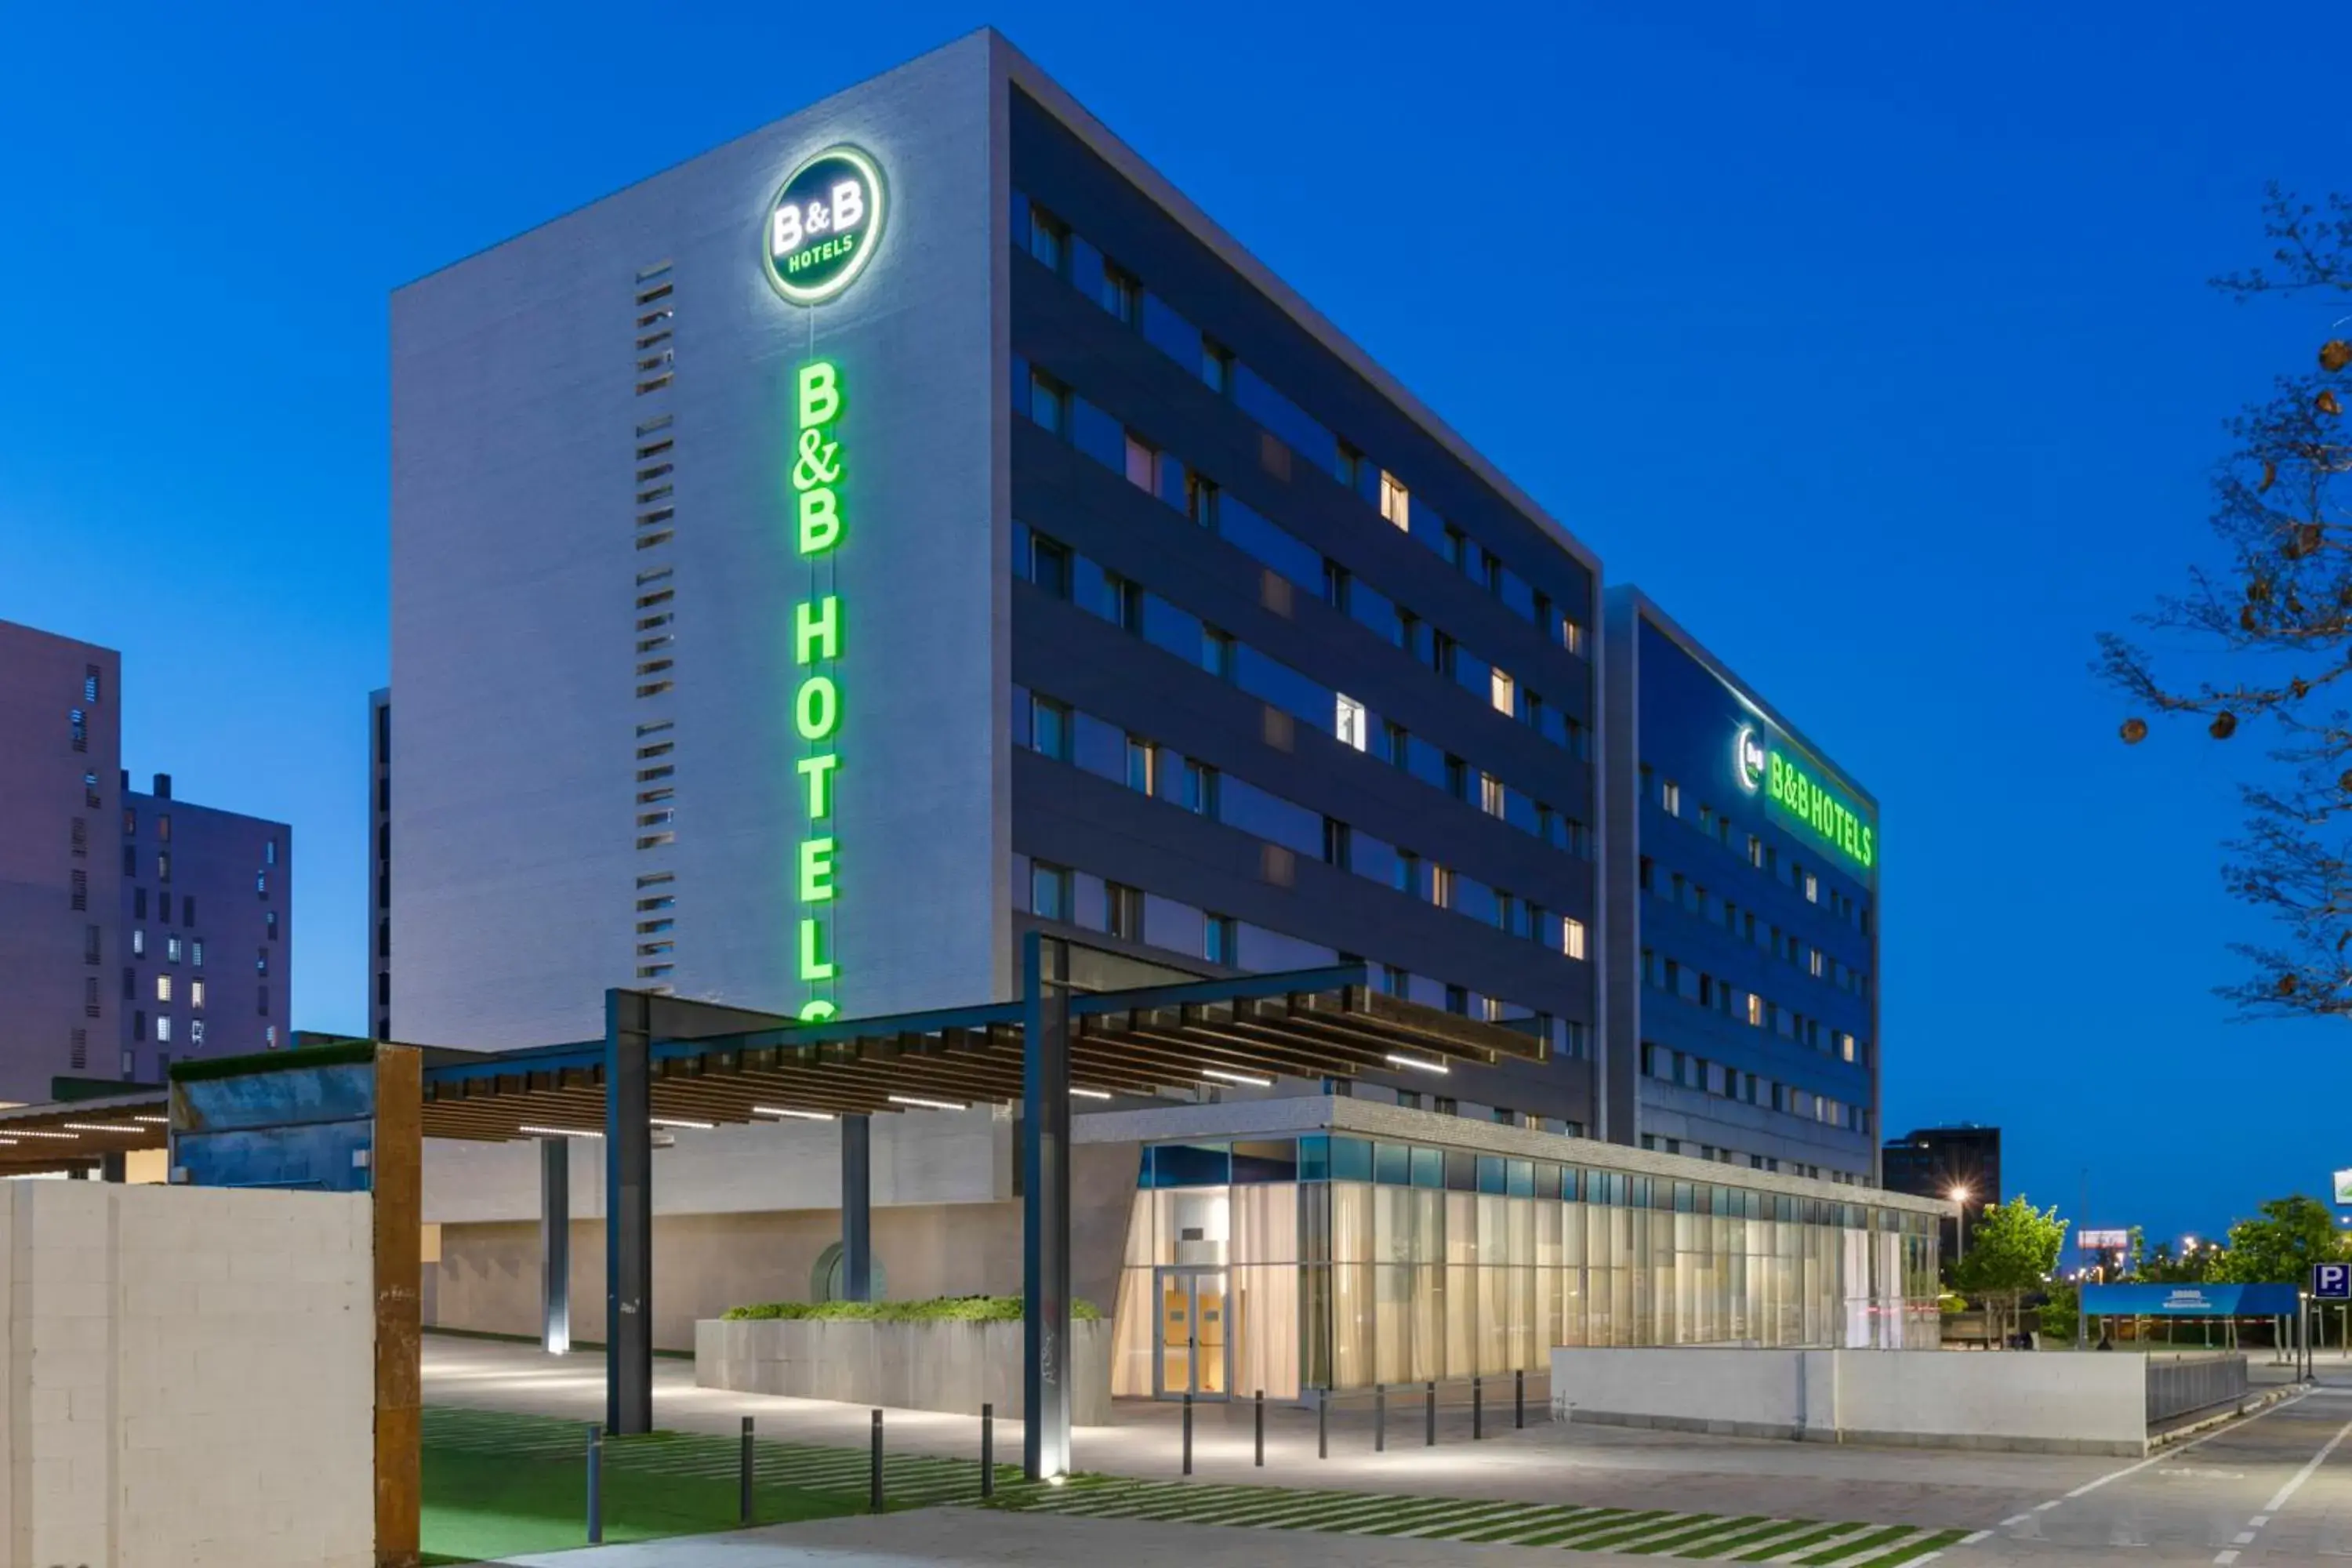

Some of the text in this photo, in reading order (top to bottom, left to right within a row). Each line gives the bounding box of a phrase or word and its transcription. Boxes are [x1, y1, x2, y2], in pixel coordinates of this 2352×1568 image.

[773, 180, 864, 256] B&B
[789, 234, 853, 273] HOTELS
[793, 361, 840, 554] B&B
[1771, 750, 1809, 819] B&B
[1812, 784, 1872, 867] HOTELS
[2321, 1266, 2343, 1290] P
